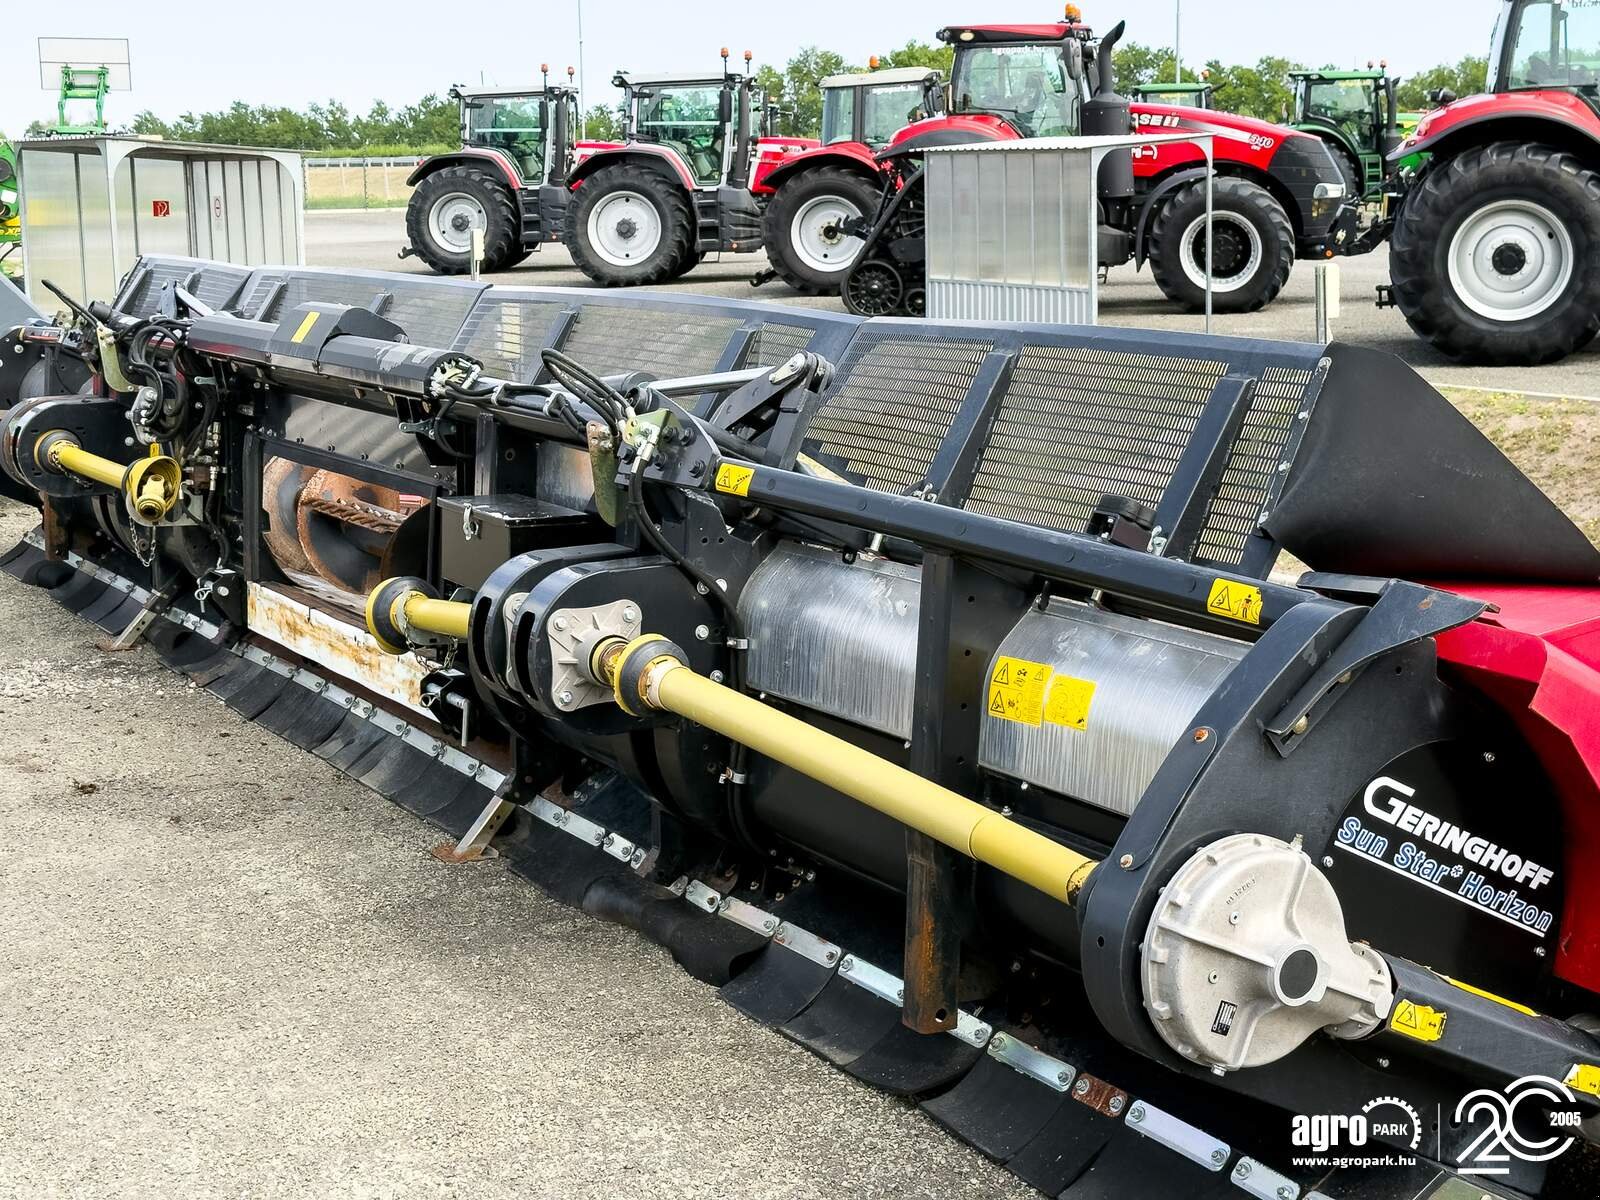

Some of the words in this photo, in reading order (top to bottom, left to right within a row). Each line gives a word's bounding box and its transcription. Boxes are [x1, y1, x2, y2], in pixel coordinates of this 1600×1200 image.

[1131, 112, 1163, 127] SE
[1337, 816, 1389, 858] Sun
[1457, 869, 1554, 933] Horizon
[1363, 776, 1554, 890] GERINGHOFF
